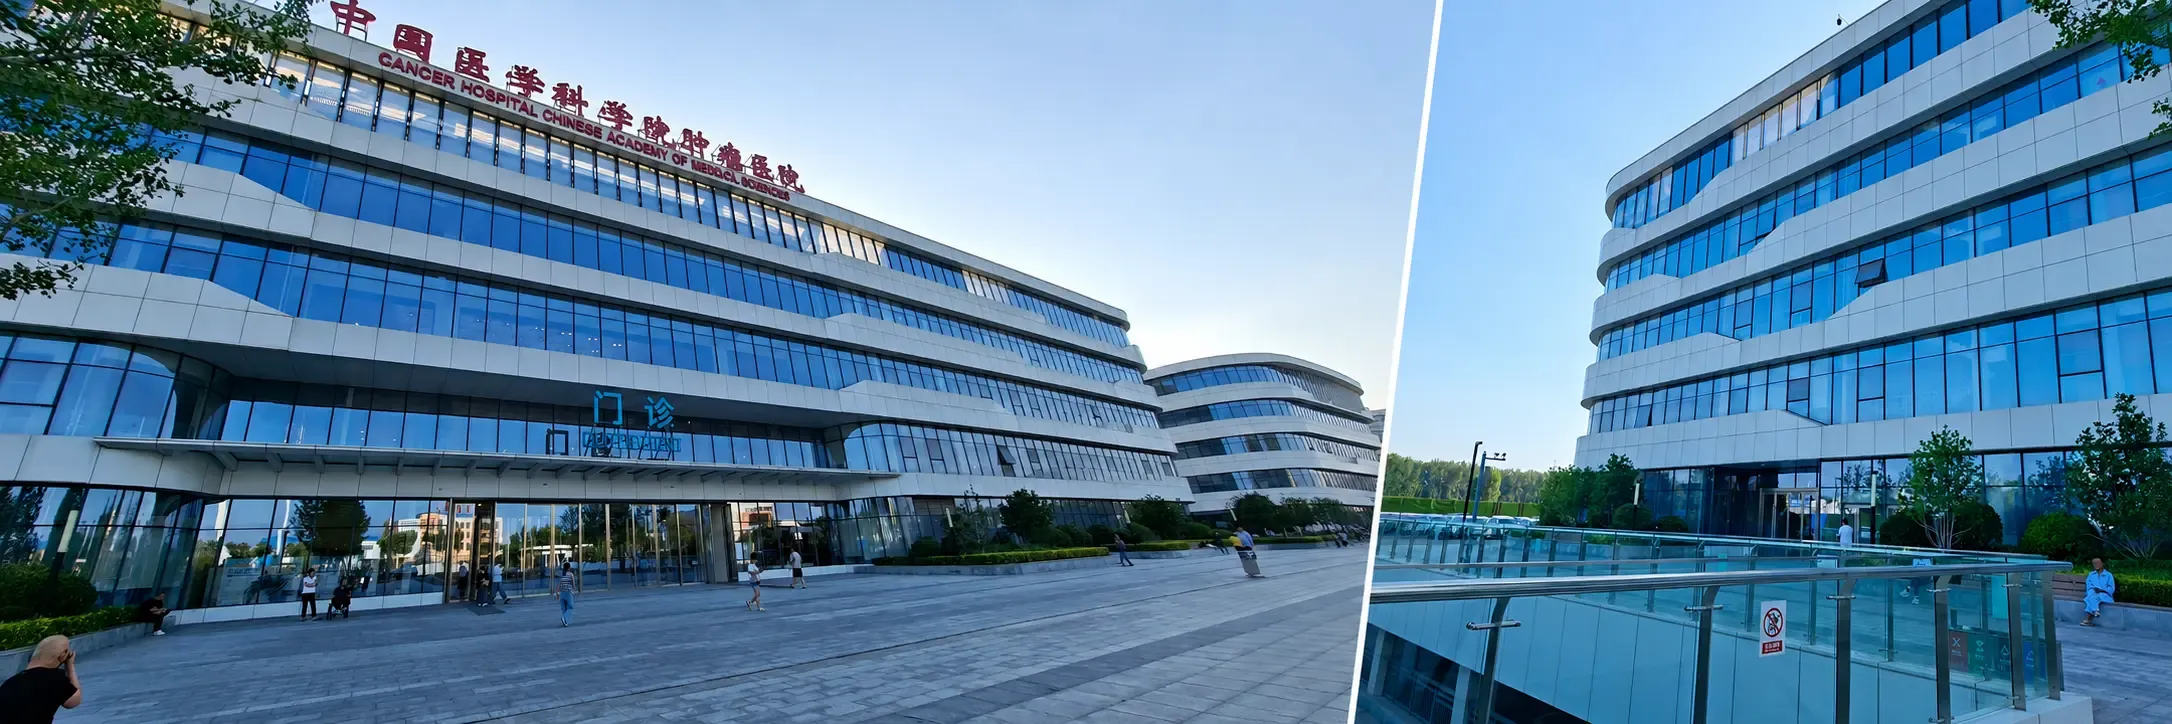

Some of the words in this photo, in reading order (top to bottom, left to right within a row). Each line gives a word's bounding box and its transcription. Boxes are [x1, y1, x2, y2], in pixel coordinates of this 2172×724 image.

[330, 0, 805, 194] 中国医学科学院肿瘤医院
[378, 52, 455, 90] CANCER
[460, 80, 538, 118] HOSPITAL
[542, 109, 603, 140] CHINESE
[606, 131, 669, 161] ACADEMY
[672, 153, 688, 166] OF
[593, 390, 675, 429] 门诊
